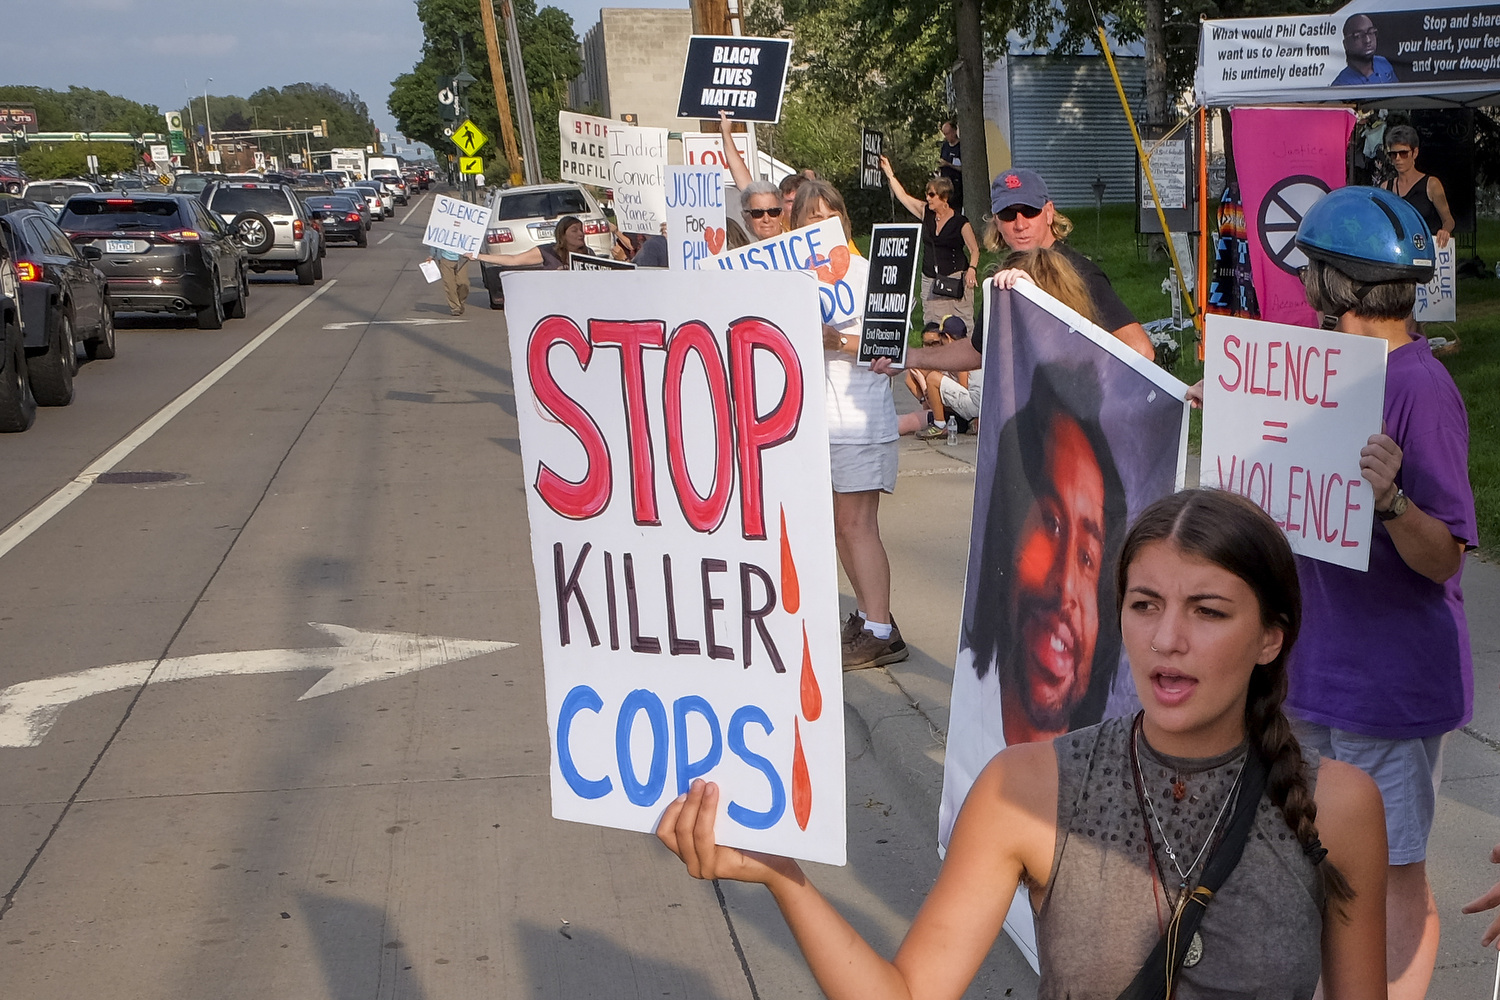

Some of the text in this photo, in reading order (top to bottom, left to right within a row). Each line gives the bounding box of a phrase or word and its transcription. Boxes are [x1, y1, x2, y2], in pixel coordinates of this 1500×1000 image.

[1212, 21, 1337, 41] What would Phil Castile
[1423, 15, 1447, 33] Stop
[1450, 13, 1470, 28] and
[1218, 43, 1330, 61] want us to learn from
[1398, 40, 1422, 55] your
[1424, 36, 1454, 53] heart,
[1457, 37, 1482, 53] your
[712, 46, 761, 66] BLACK
[1412, 57, 1431, 72] and
[1433, 58, 1457, 75] your
[712, 67, 753, 86] LIVES
[1222, 62, 1325, 81] his untimely death?
[700, 88, 758, 108] MATTER
[571, 141, 605, 159] RACE
[609, 130, 665, 158] Indict
[618, 187, 642, 204] Send
[665, 172, 722, 208] JUSTICE
[437, 199, 488, 226] SILENCE
[620, 205, 656, 221] Yanez
[685, 215, 707, 233] FOR
[427, 225, 480, 252] VIOLENCE
[877, 237, 910, 257] JUSTICE
[881, 265, 898, 285] FOR
[1439, 252, 1453, 299] BLUE
[867, 293, 907, 313] PHILANDO
[866, 328, 901, 341] End Racism In
[862, 343, 901, 358] Our Community
[1218, 334, 1341, 408] SILENCE
[527, 314, 804, 541] STOP
[1217, 455, 1361, 547] VIOLENCE
[554, 542, 787, 674] KILLER
[556, 685, 787, 830] COPS
